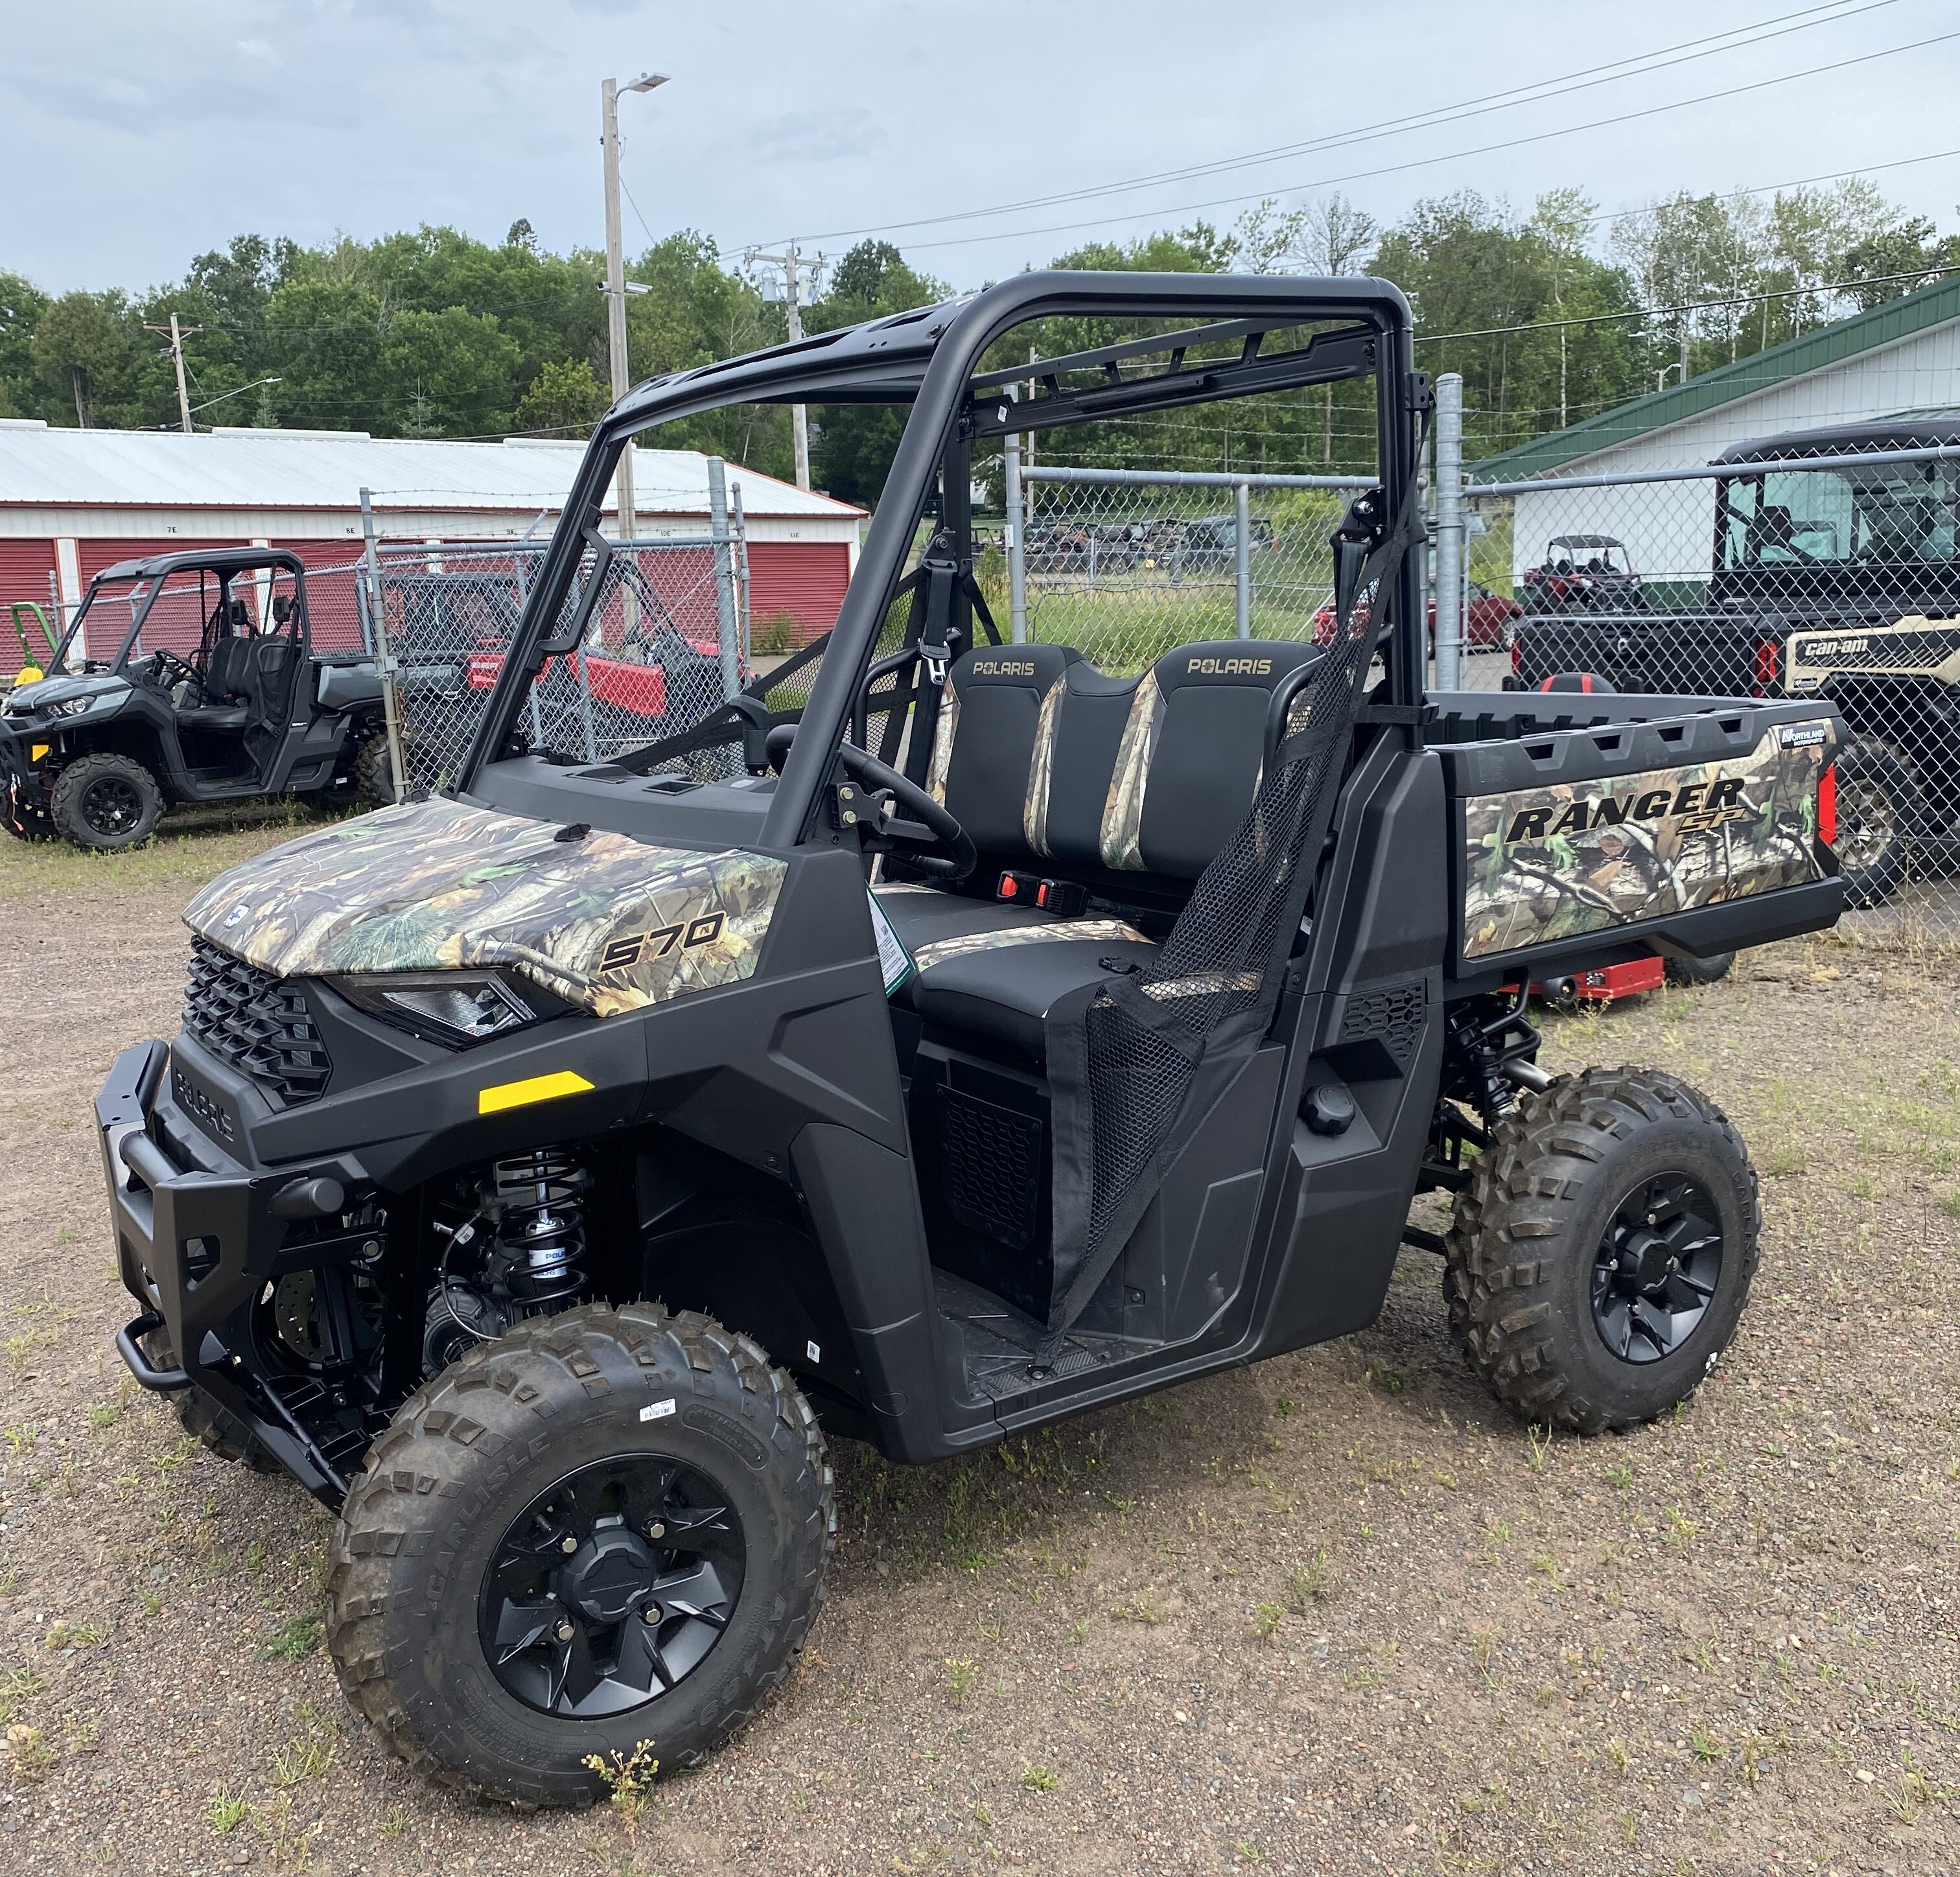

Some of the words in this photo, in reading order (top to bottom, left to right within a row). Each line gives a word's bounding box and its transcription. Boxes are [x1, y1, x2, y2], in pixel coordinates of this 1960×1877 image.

[1804, 638, 1869, 657] can-am
[972, 661, 1035, 676] POLARIS
[1187, 658, 1272, 675] POLARIS
[1781, 728, 1825, 743] NORTHLAND
[1504, 778, 1745, 845] RANGER
[1676, 808, 1745, 836] SP
[596, 910, 727, 975] 570
